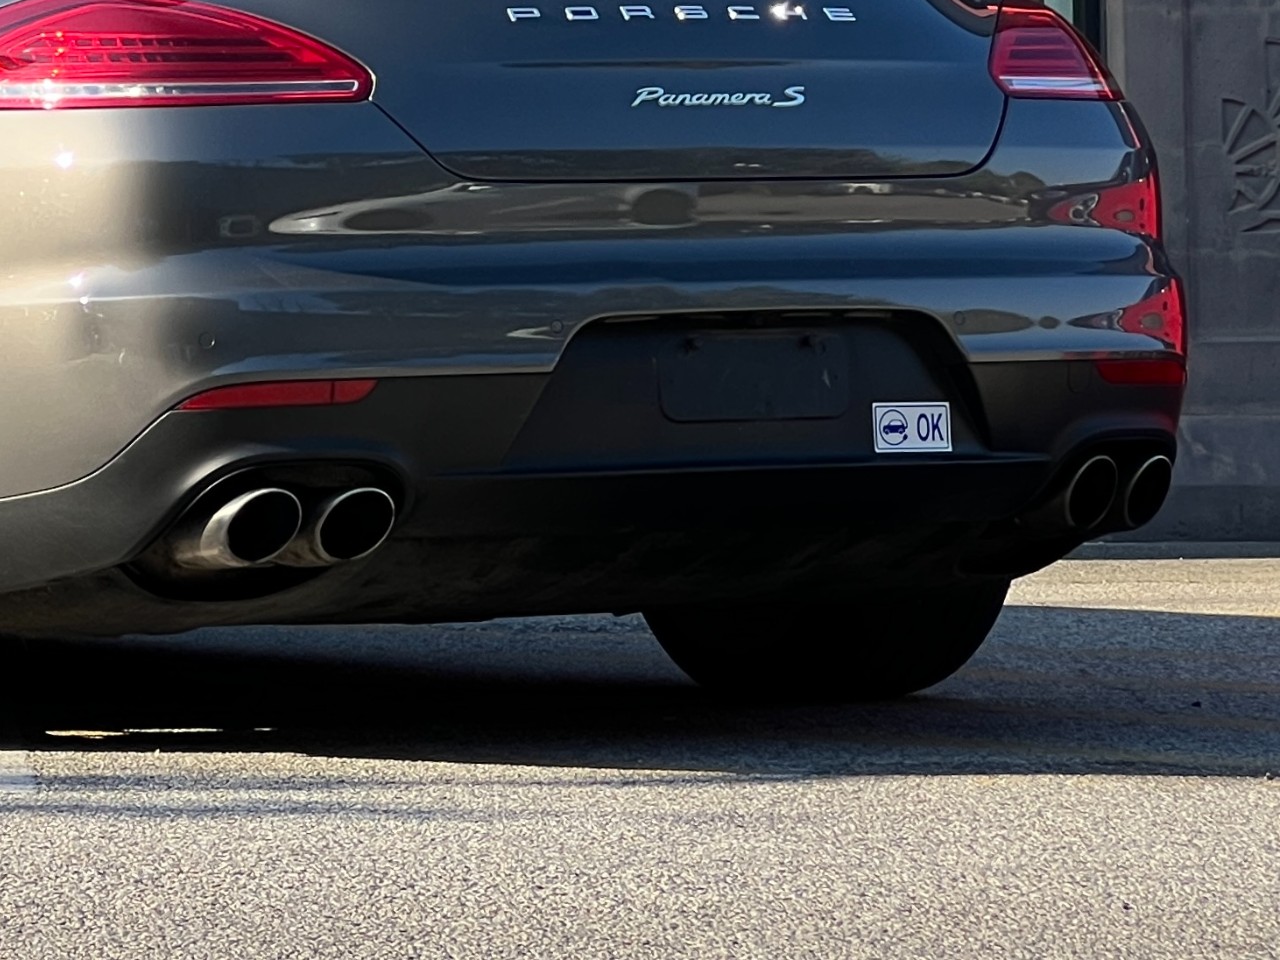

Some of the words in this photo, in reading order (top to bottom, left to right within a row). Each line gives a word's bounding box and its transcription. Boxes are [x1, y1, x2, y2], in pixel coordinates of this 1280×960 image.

[506, 3, 857, 22] PORSCHE
[631, 86, 771, 107] Panamera
[771, 86, 805, 107] S
[916, 412, 945, 442] OK
